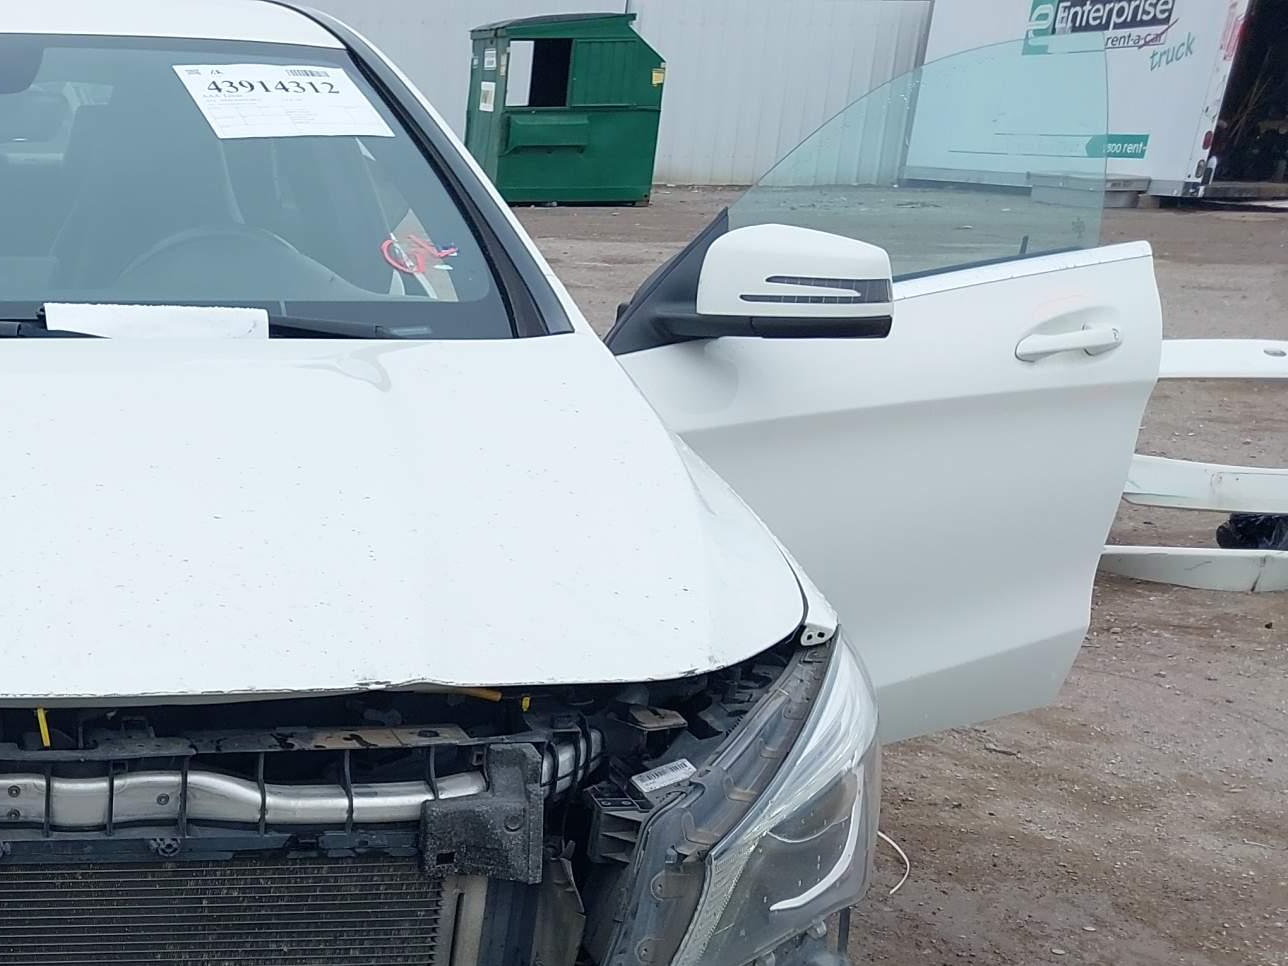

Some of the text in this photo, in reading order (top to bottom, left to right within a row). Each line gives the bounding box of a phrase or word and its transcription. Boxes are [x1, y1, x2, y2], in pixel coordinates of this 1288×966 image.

[1054, 0, 1175, 33] Enterprise
[1149, 32, 1195, 72] truck
[207, 80, 340, 94] 43914312
